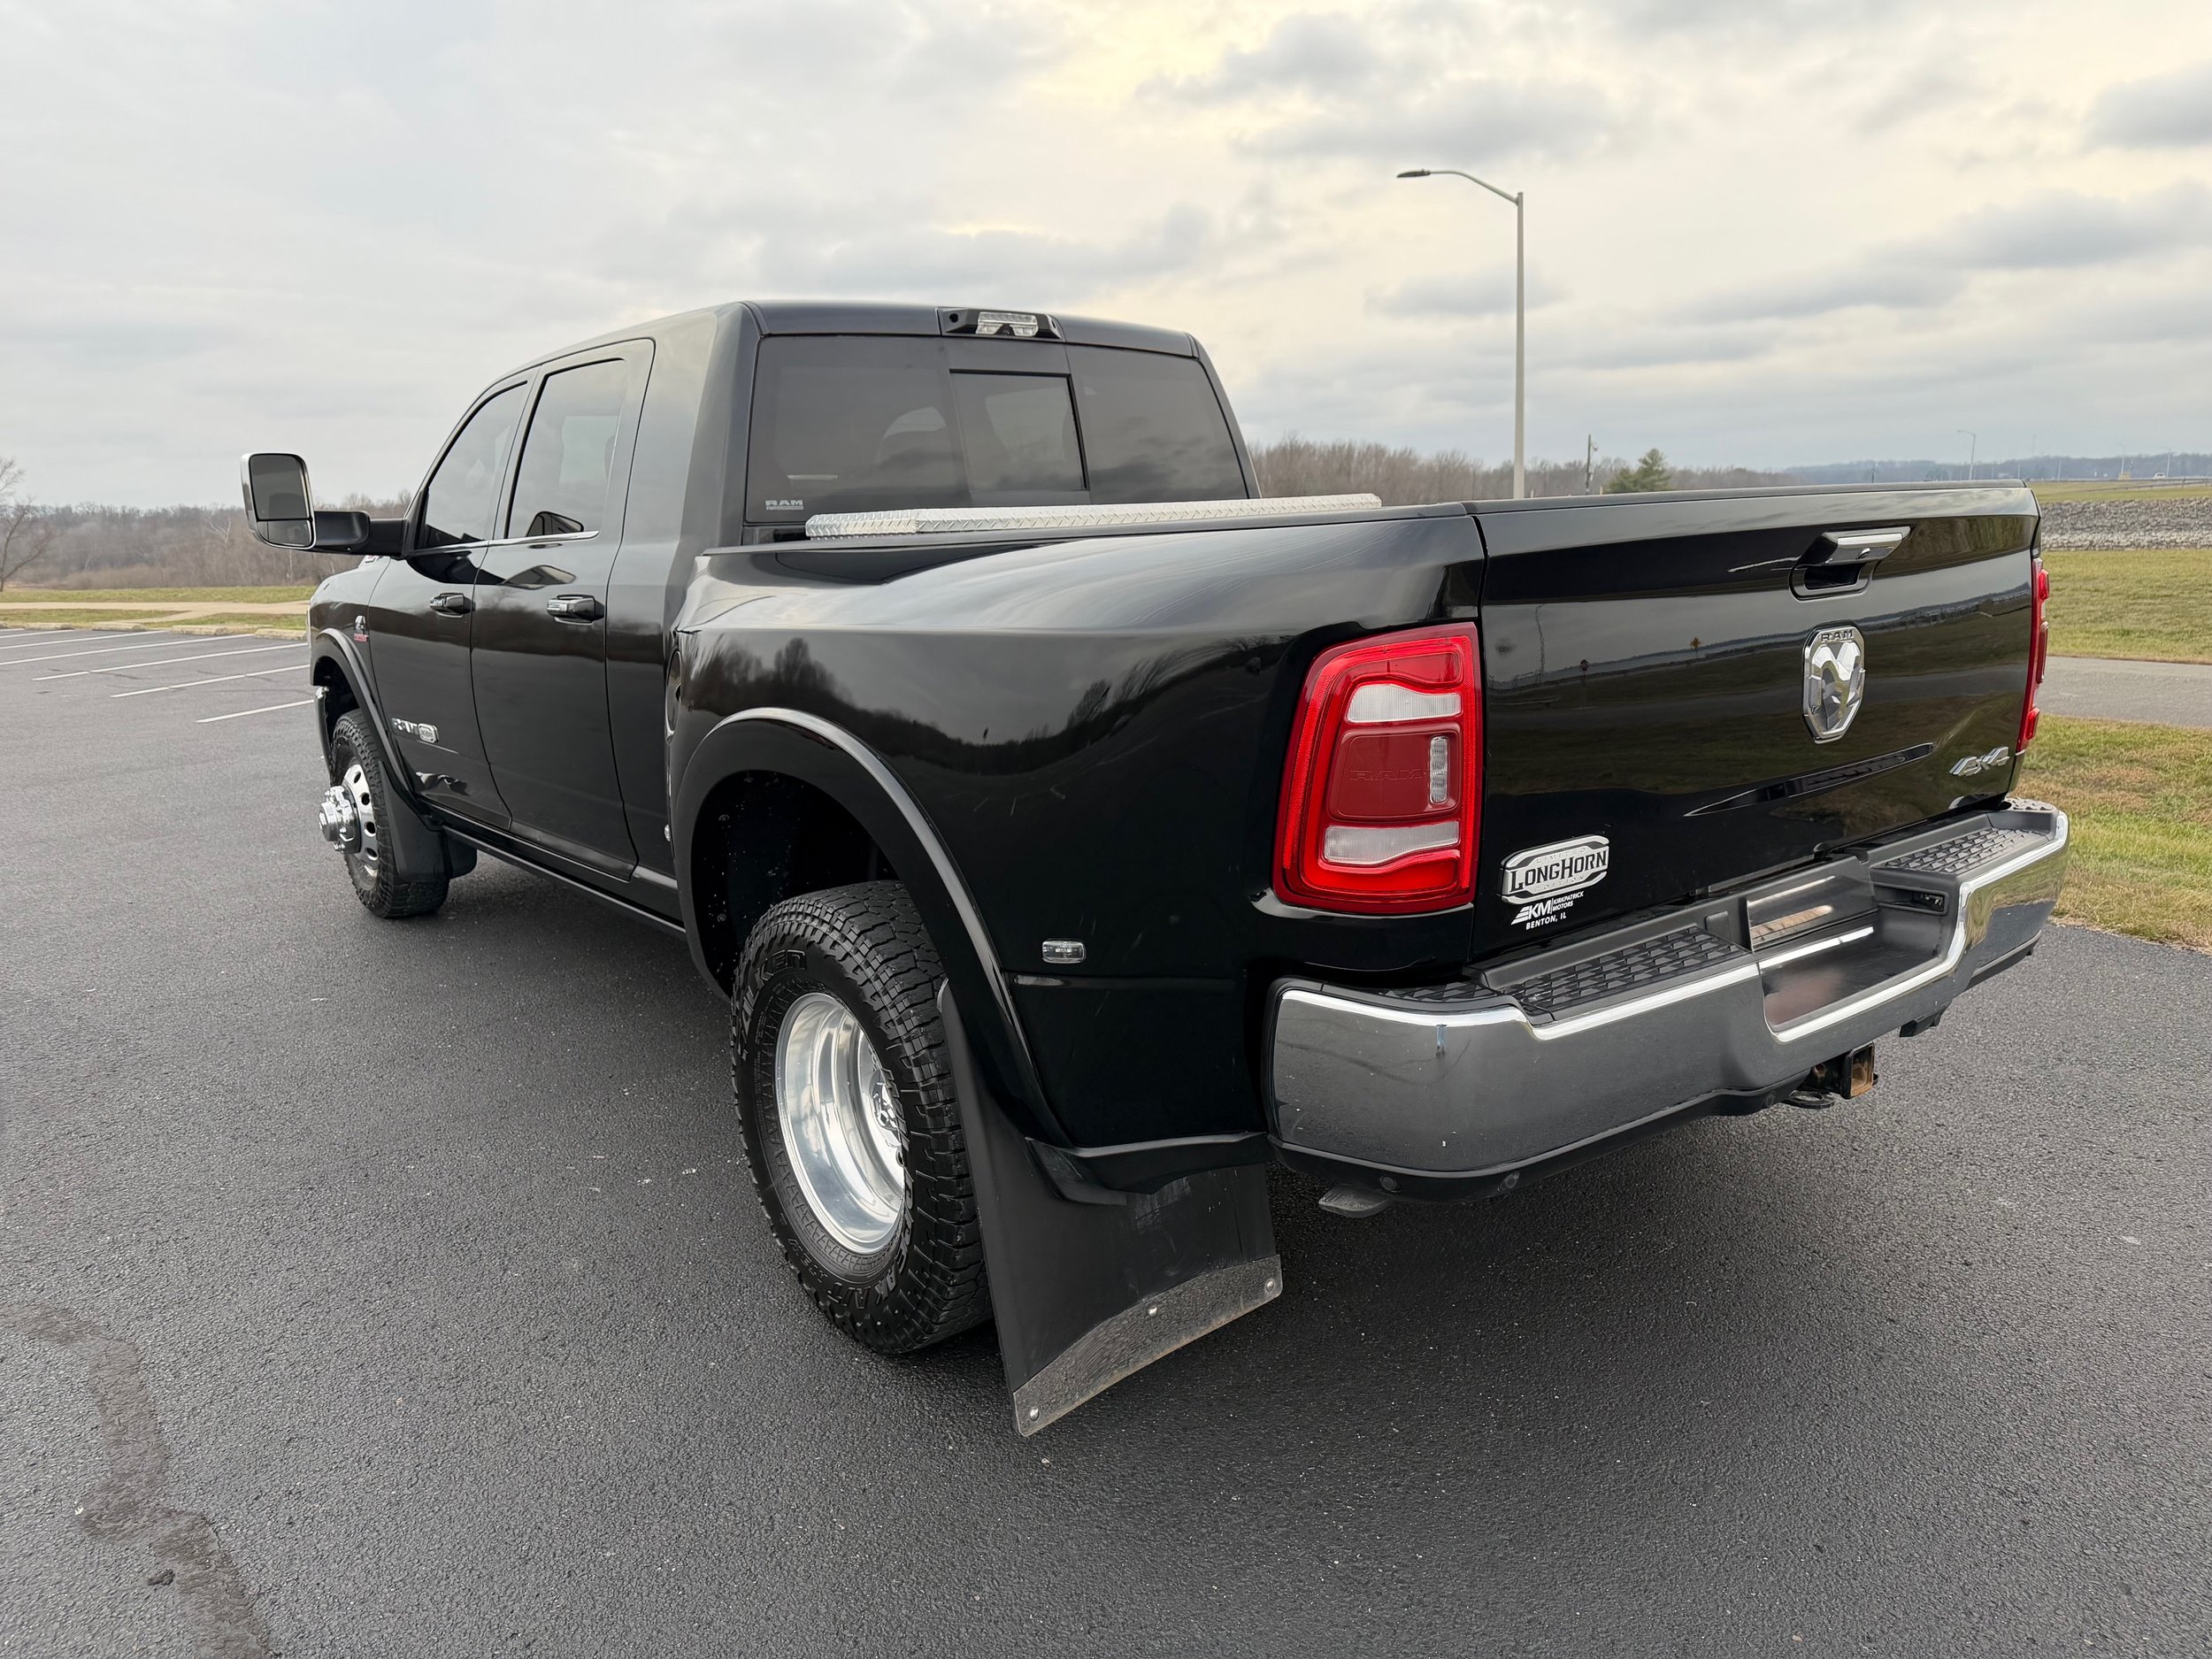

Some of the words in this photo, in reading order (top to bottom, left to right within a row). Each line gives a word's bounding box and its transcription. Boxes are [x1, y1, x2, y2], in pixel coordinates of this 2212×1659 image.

[1821, 629, 1854, 642] RAM
[1349, 768, 1423, 781] RAM
[1554, 890, 1585, 904] KIRKPATRICK
[1553, 900, 1574, 912] MOTORS
[1525, 914, 1558, 931] BENTON,
[1560, 911, 1567, 920] IL
